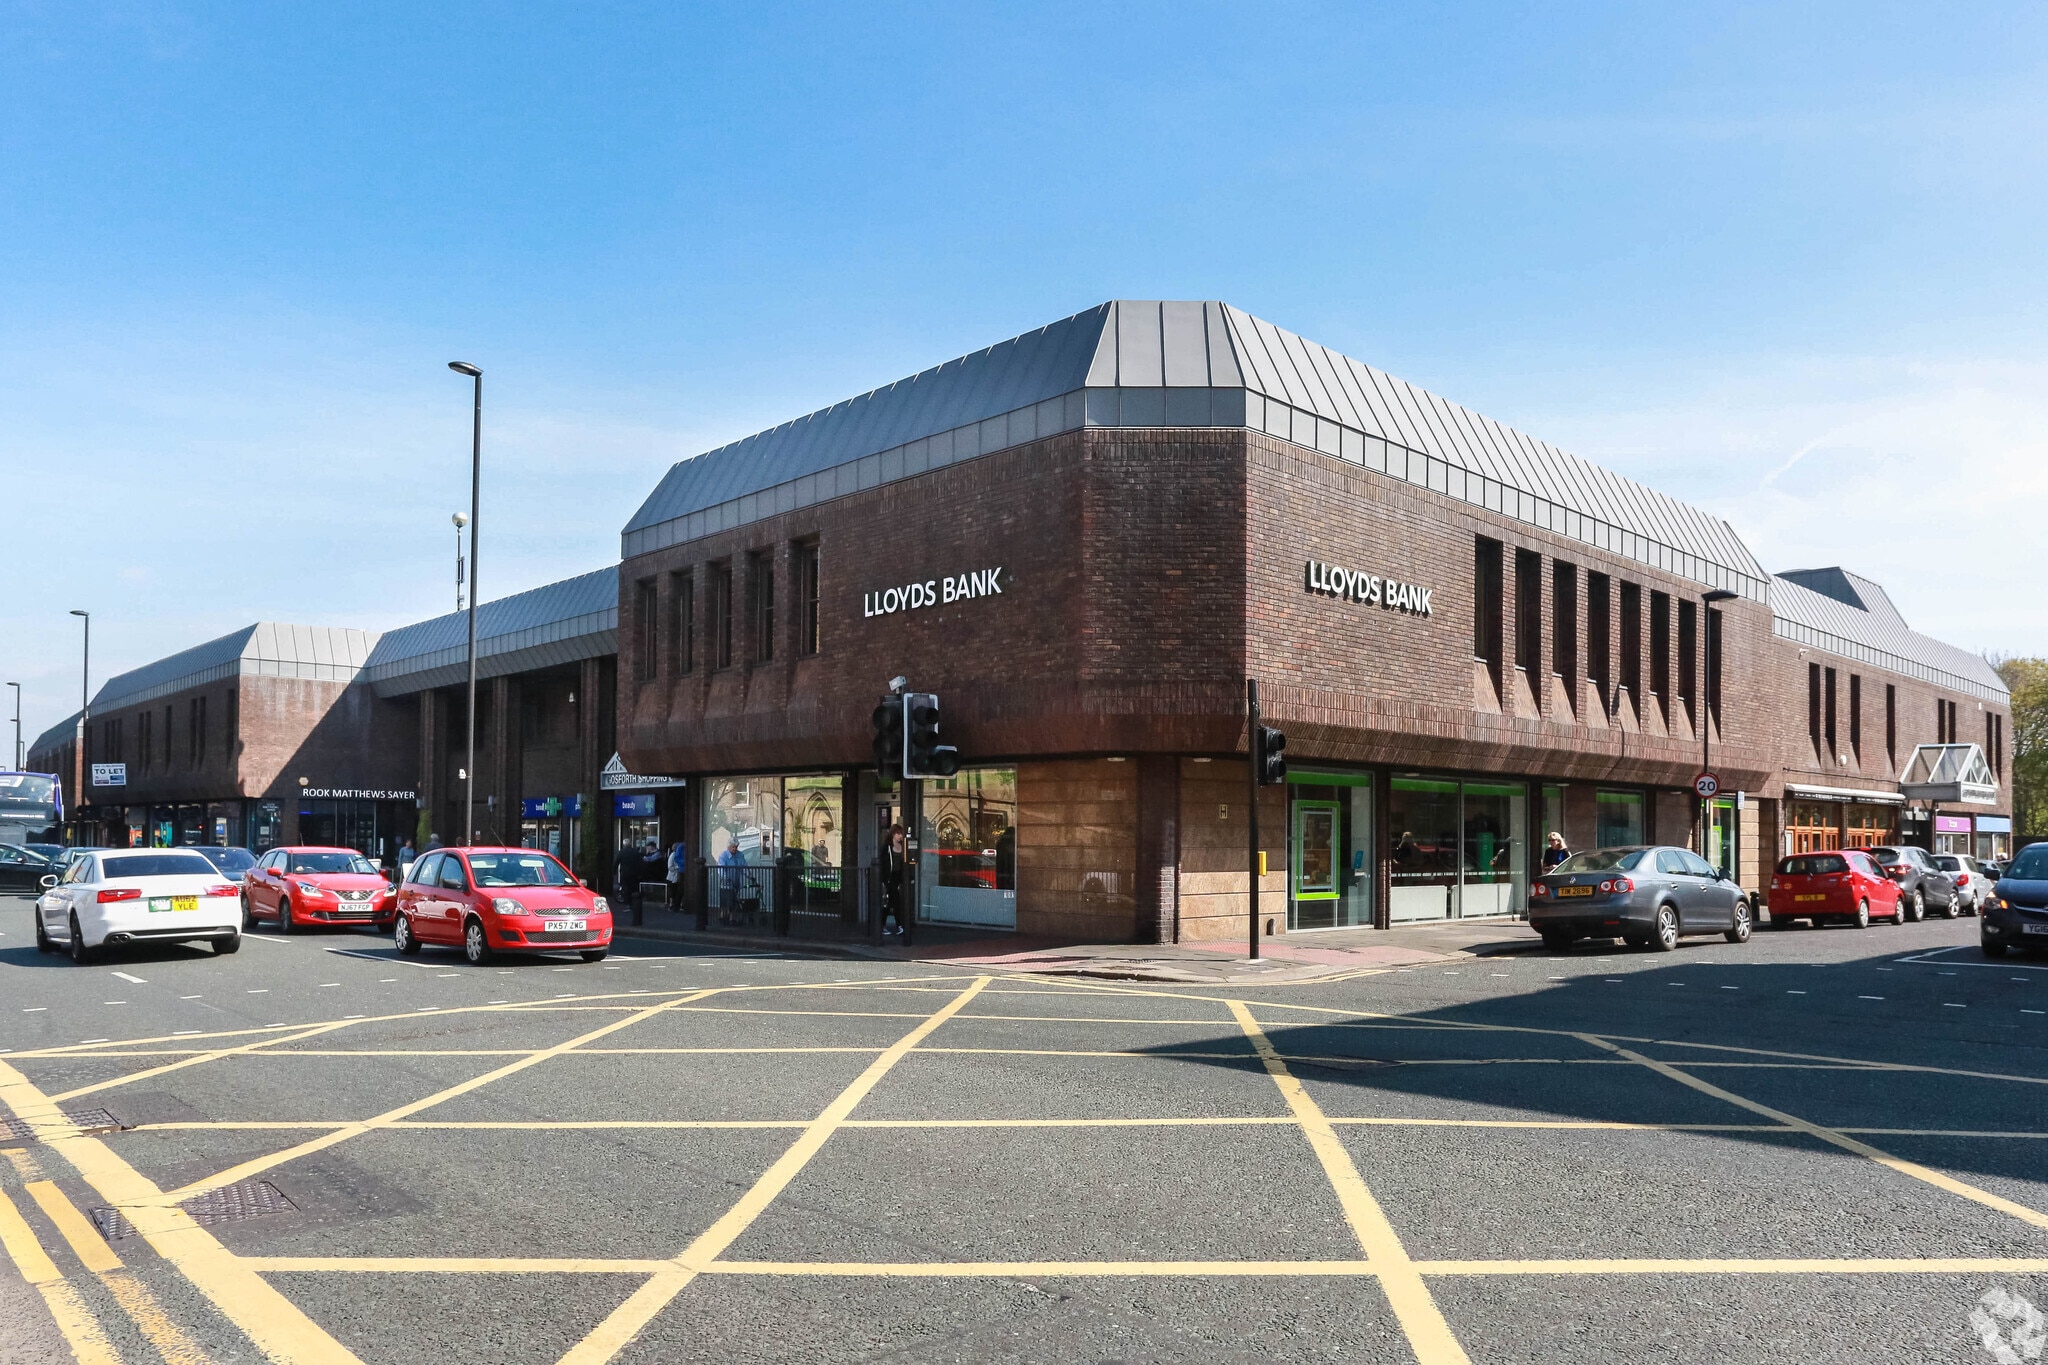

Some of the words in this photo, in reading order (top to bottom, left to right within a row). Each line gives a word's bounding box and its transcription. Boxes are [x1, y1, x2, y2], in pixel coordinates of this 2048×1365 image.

[865, 580, 937, 618] LLOYDS
[943, 566, 1002, 604] BANK
[1310, 560, 1380, 602] LLOYDS
[1386, 579, 1433, 614] BANK
[1698, 780, 1716, 792] 20
[302, 788, 330, 797] ROOK
[332, 789, 386, 799] MATTHEWS
[387, 790, 415, 799] SAYER
[622, 801, 636, 810] beauty
[178, 902, 194, 910] YLE
[548, 921, 568, 930] PX57
